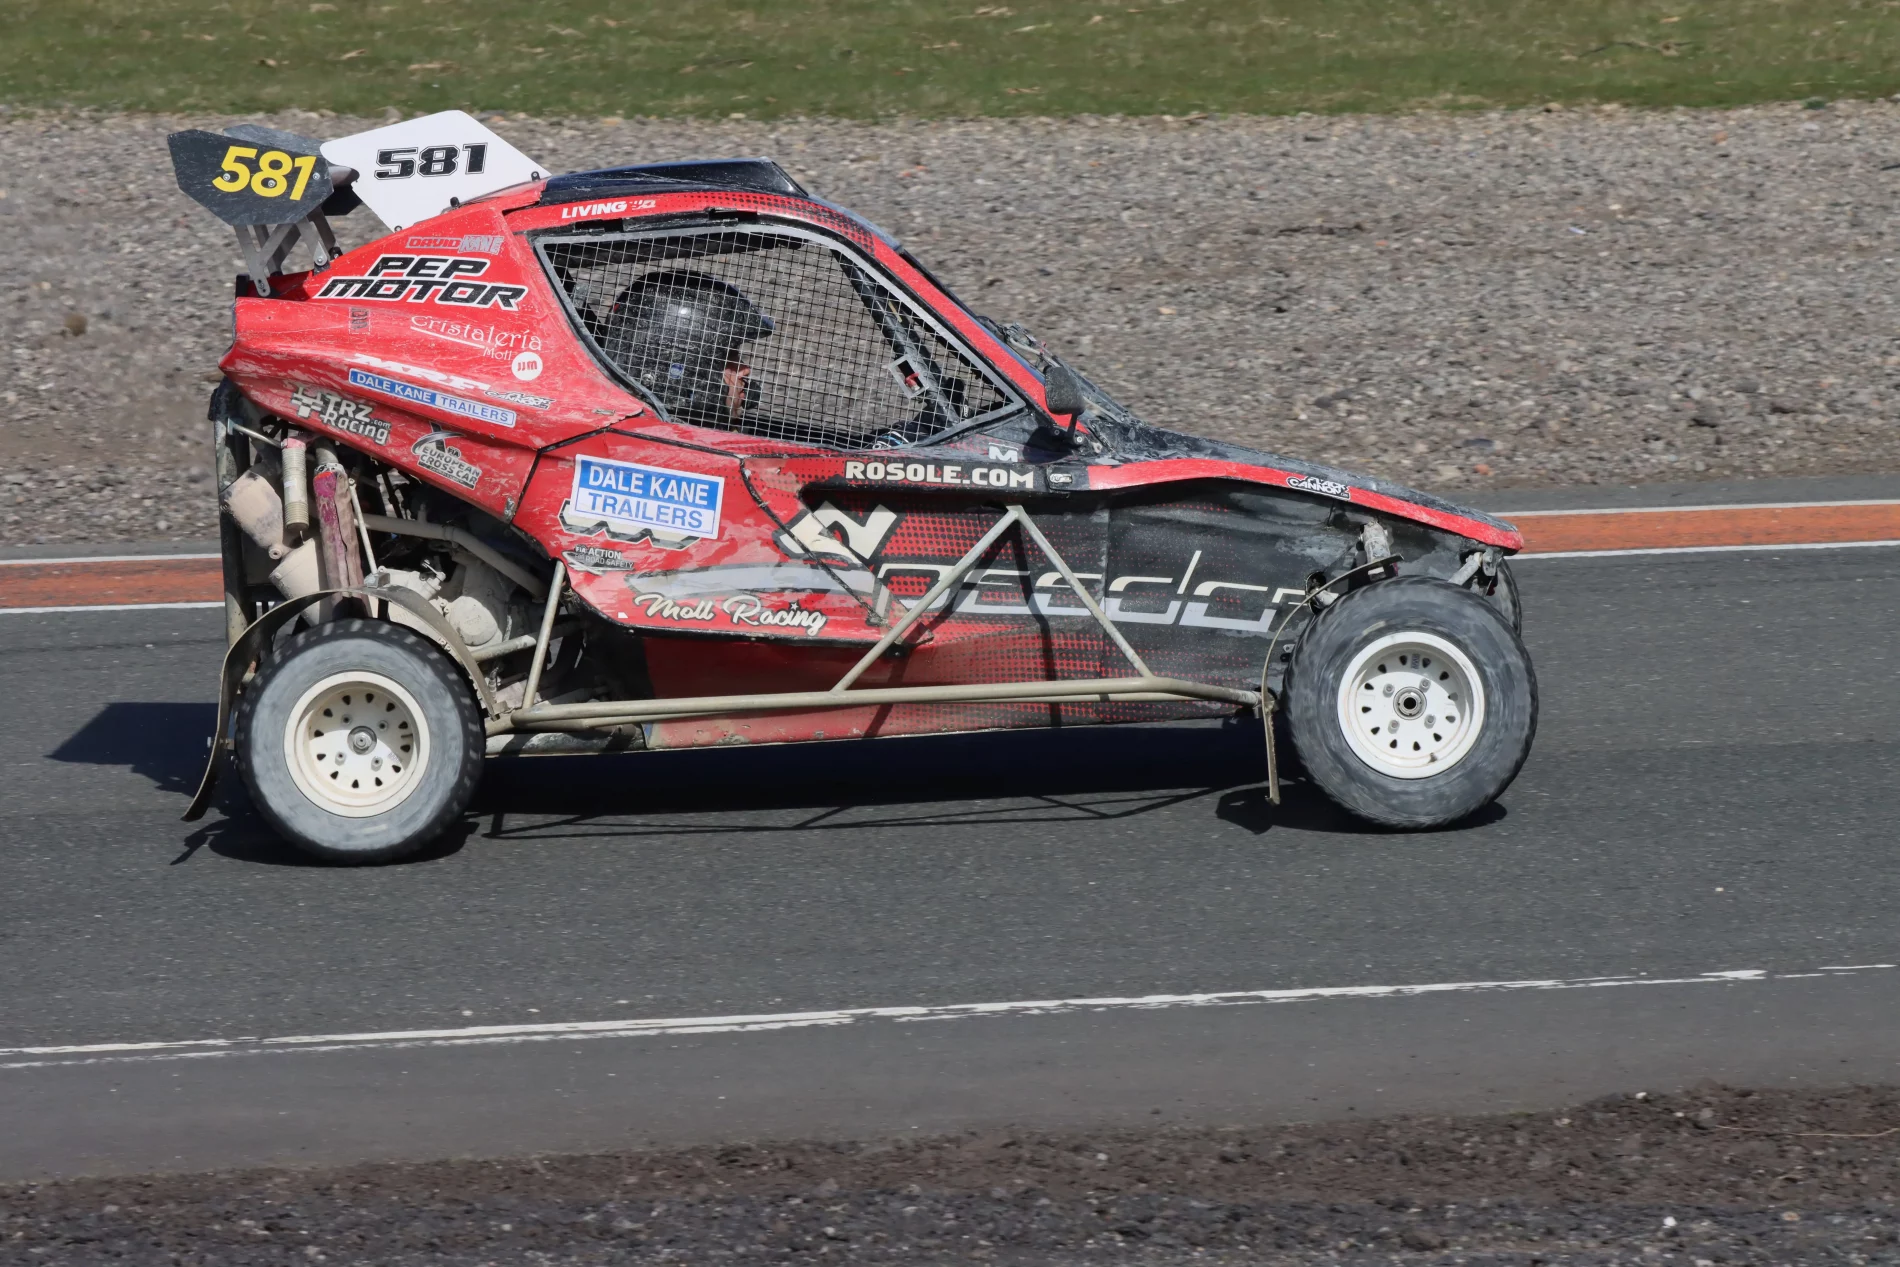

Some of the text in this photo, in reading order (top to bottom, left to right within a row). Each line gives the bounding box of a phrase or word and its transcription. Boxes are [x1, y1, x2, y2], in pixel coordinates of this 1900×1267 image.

[212, 146, 317, 200] 581
[374, 142, 488, 180] 581
[561, 201, 627, 218] LIVING
[407, 237, 462, 249] DAVID
[366, 254, 490, 281] PEP
[313, 277, 528, 311] MOTOR
[411, 315, 542, 351] Cristalería
[483, 347, 512, 360] Moll
[356, 373, 391, 392] DALE
[394, 384, 432, 403] KANE
[441, 396, 509, 422] TRAILERS
[320, 409, 389, 445] Racing
[420, 454, 454, 474] CROSS
[456, 470, 478, 484] CAR
[422, 446, 480, 477] EUROPEAN
[845, 461, 1034, 489] ROSOLE.COM
[588, 466, 709, 505] DALE KANE
[1289, 478, 1342, 495] CANNON
[588, 492, 703, 529] TRAILERS
[575, 546, 622, 560] FIA ACTION
[586, 556, 605, 565] ROAD
[605, 558, 634, 569] SAFETY
[635, 593, 827, 636] Moll Racing
